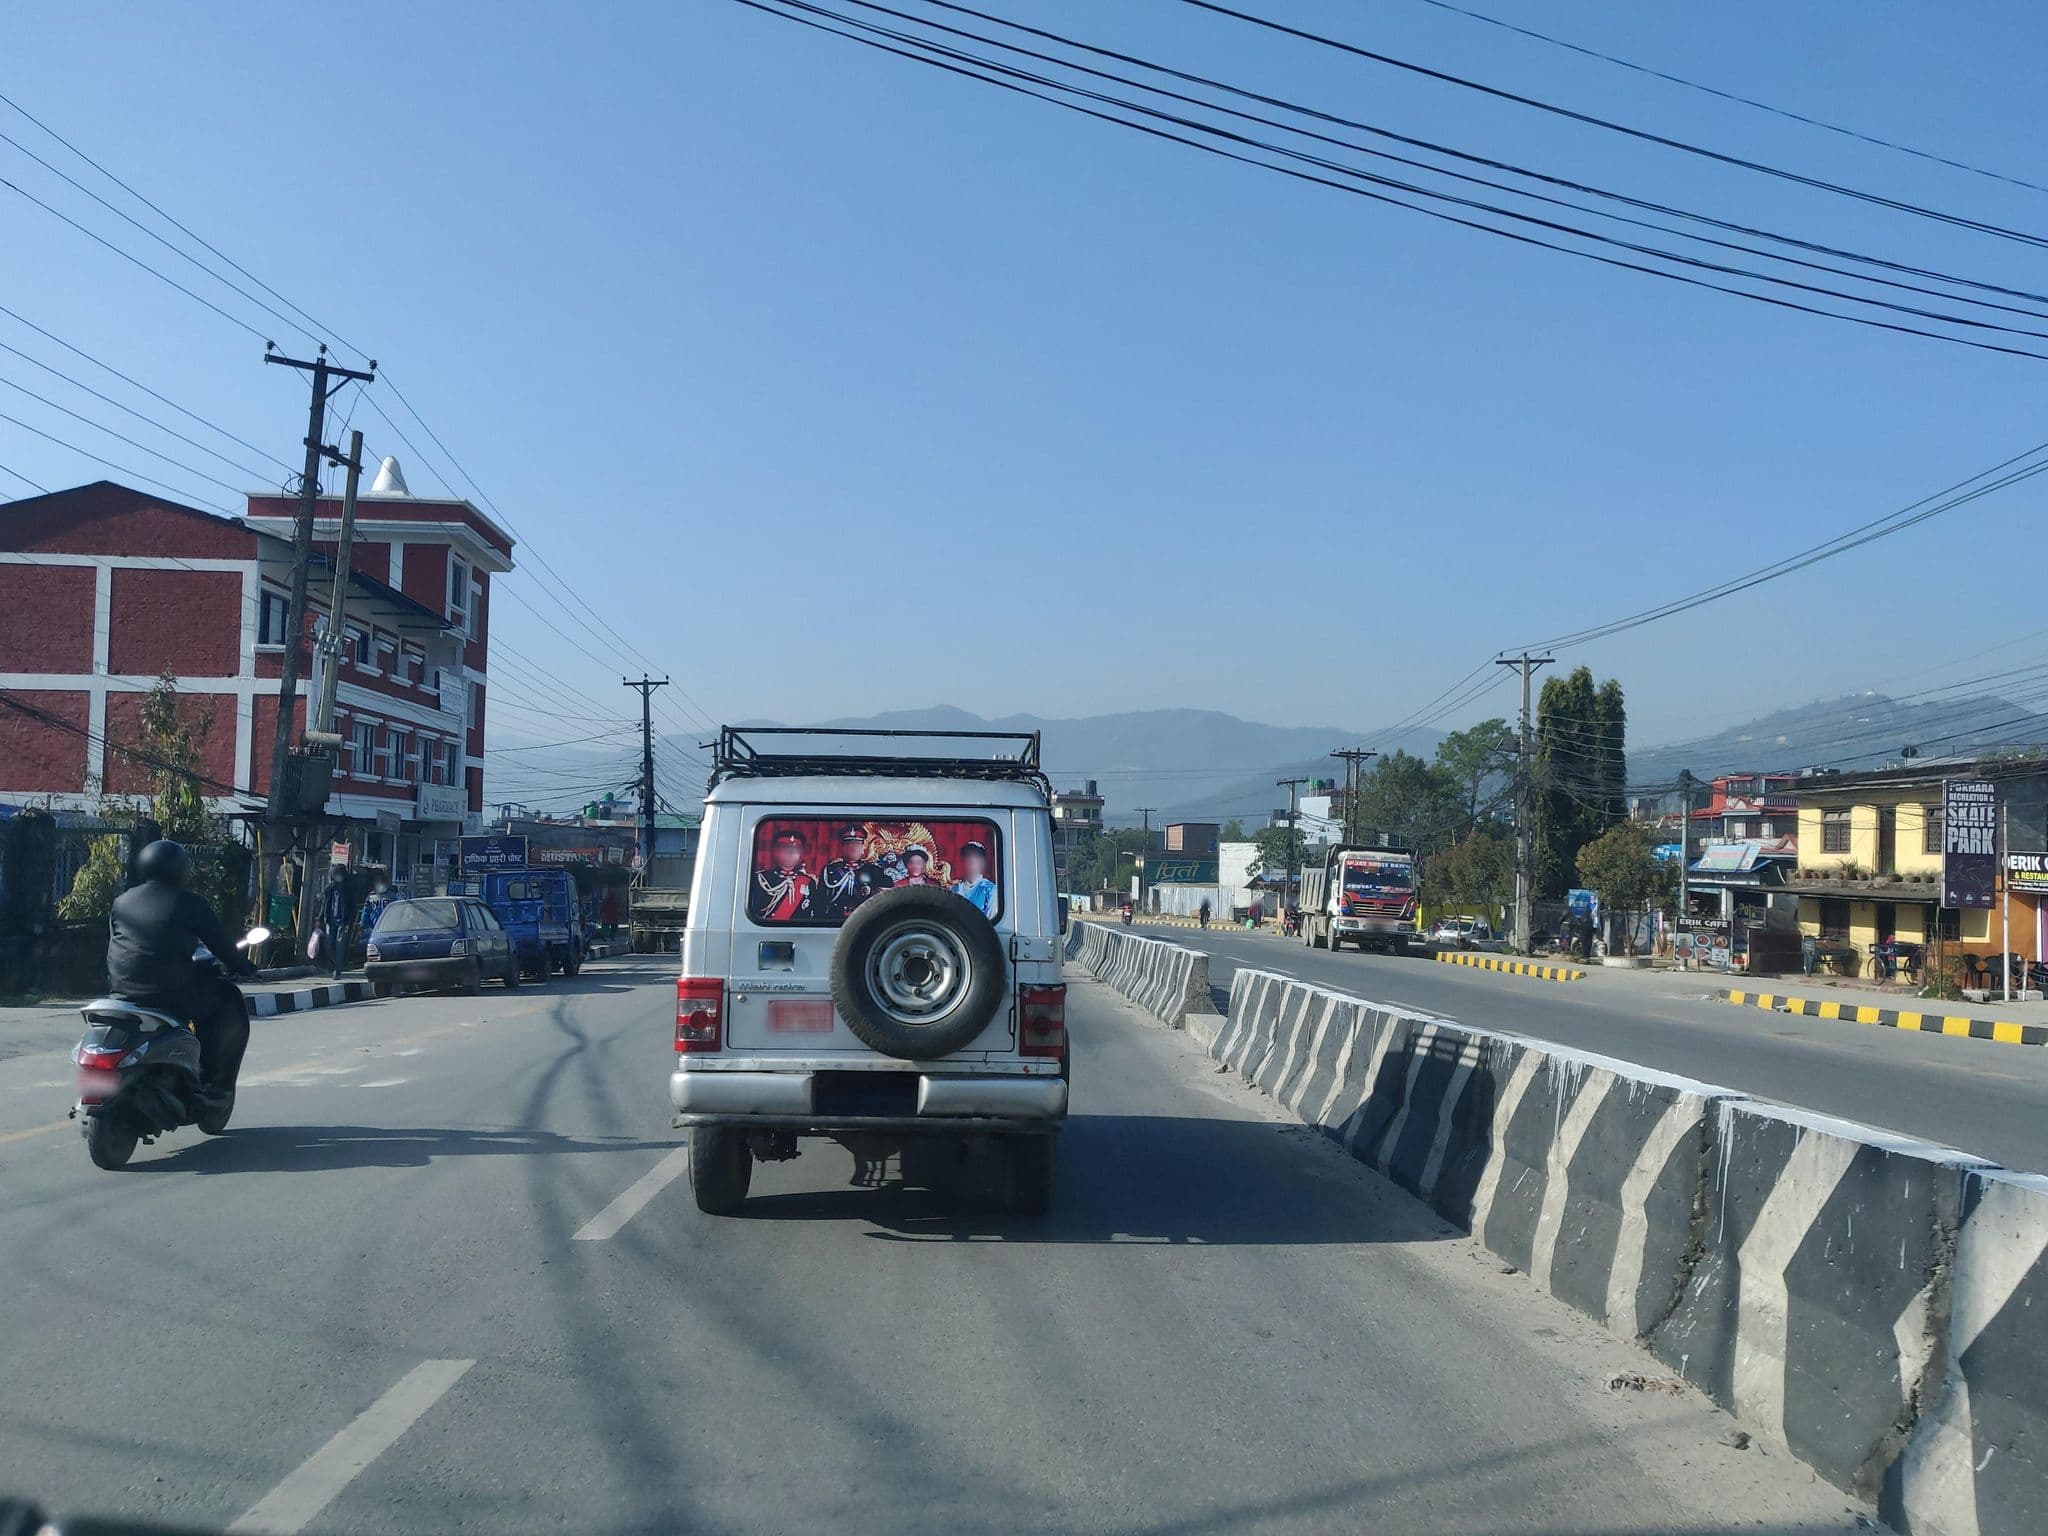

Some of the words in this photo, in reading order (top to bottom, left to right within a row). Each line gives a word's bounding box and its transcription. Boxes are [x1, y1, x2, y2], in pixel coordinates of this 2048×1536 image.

[1949, 783, 1994, 792] POKHARA
[1949, 793, 1988, 801] RECREATION
[1948, 802, 1995, 827] SKATE
[1947, 827, 1994, 854] PARK
